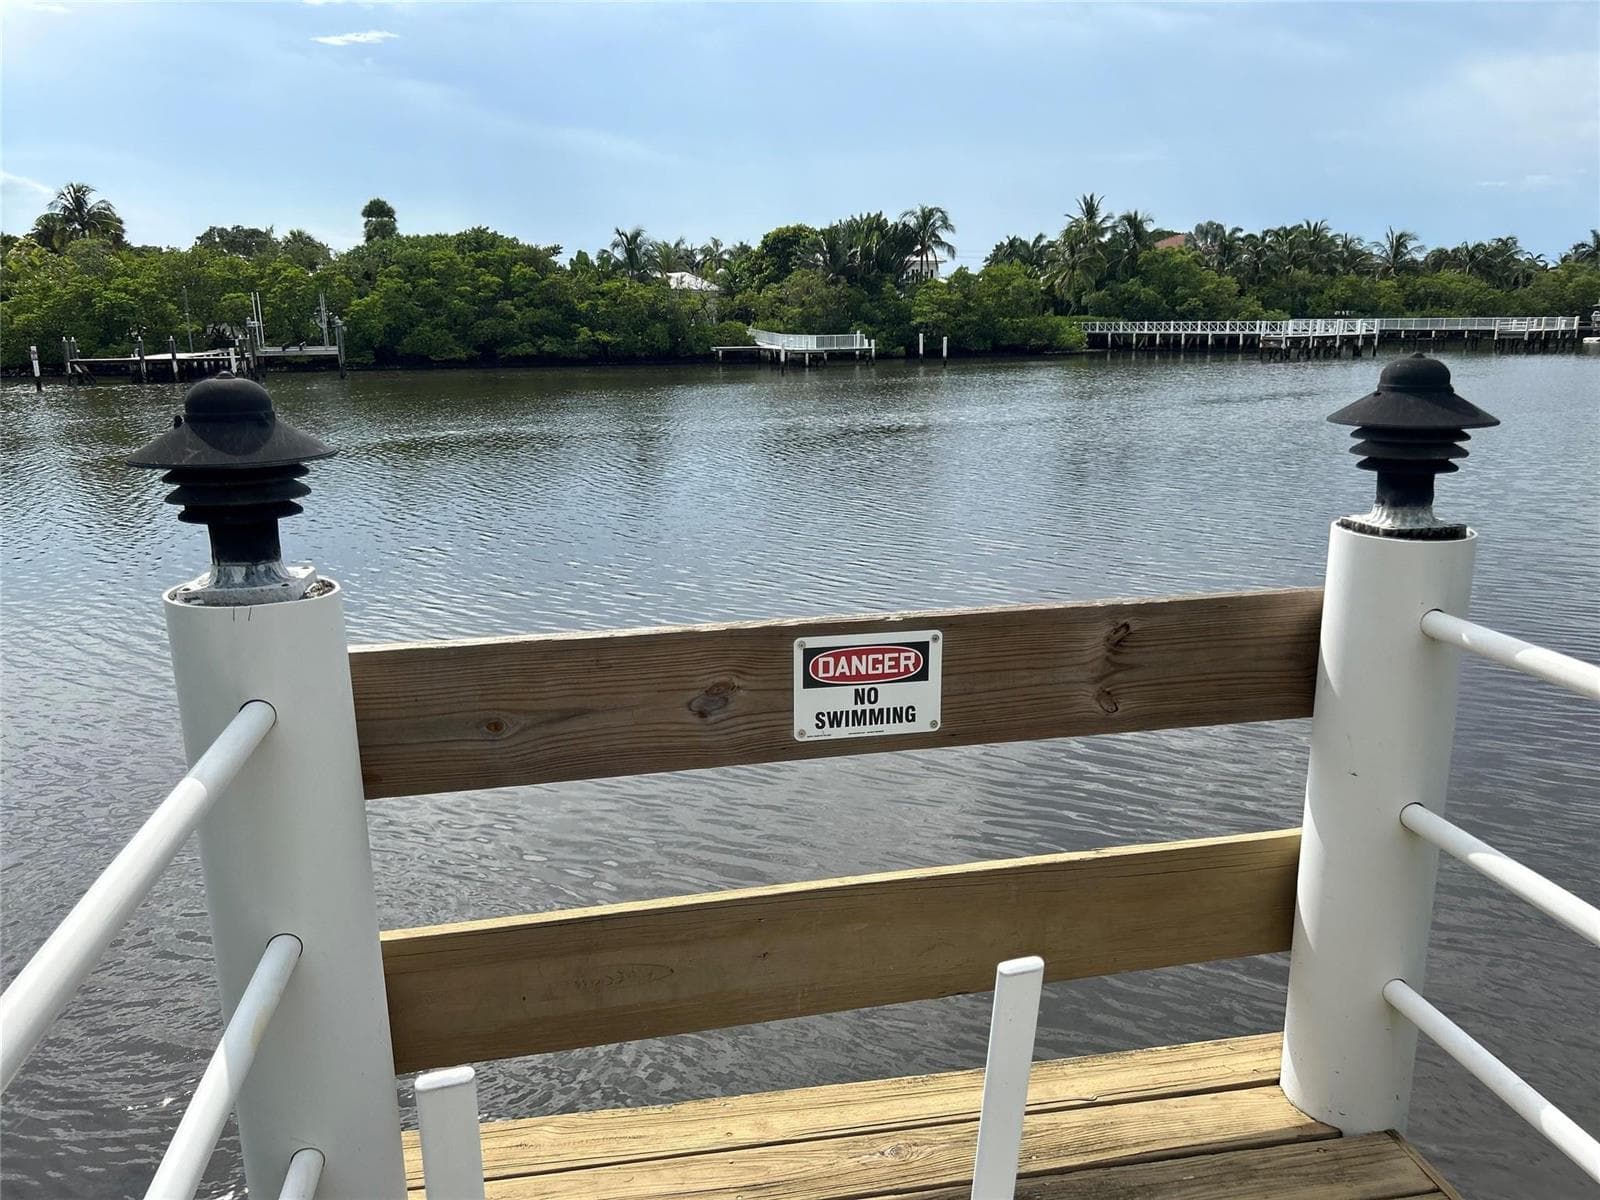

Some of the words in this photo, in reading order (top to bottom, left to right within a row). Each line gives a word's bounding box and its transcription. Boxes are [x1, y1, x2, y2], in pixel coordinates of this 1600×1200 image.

[818, 652, 915, 678] DANGER
[854, 687, 879, 705] NO
[815, 705, 916, 729] SWIMMING
